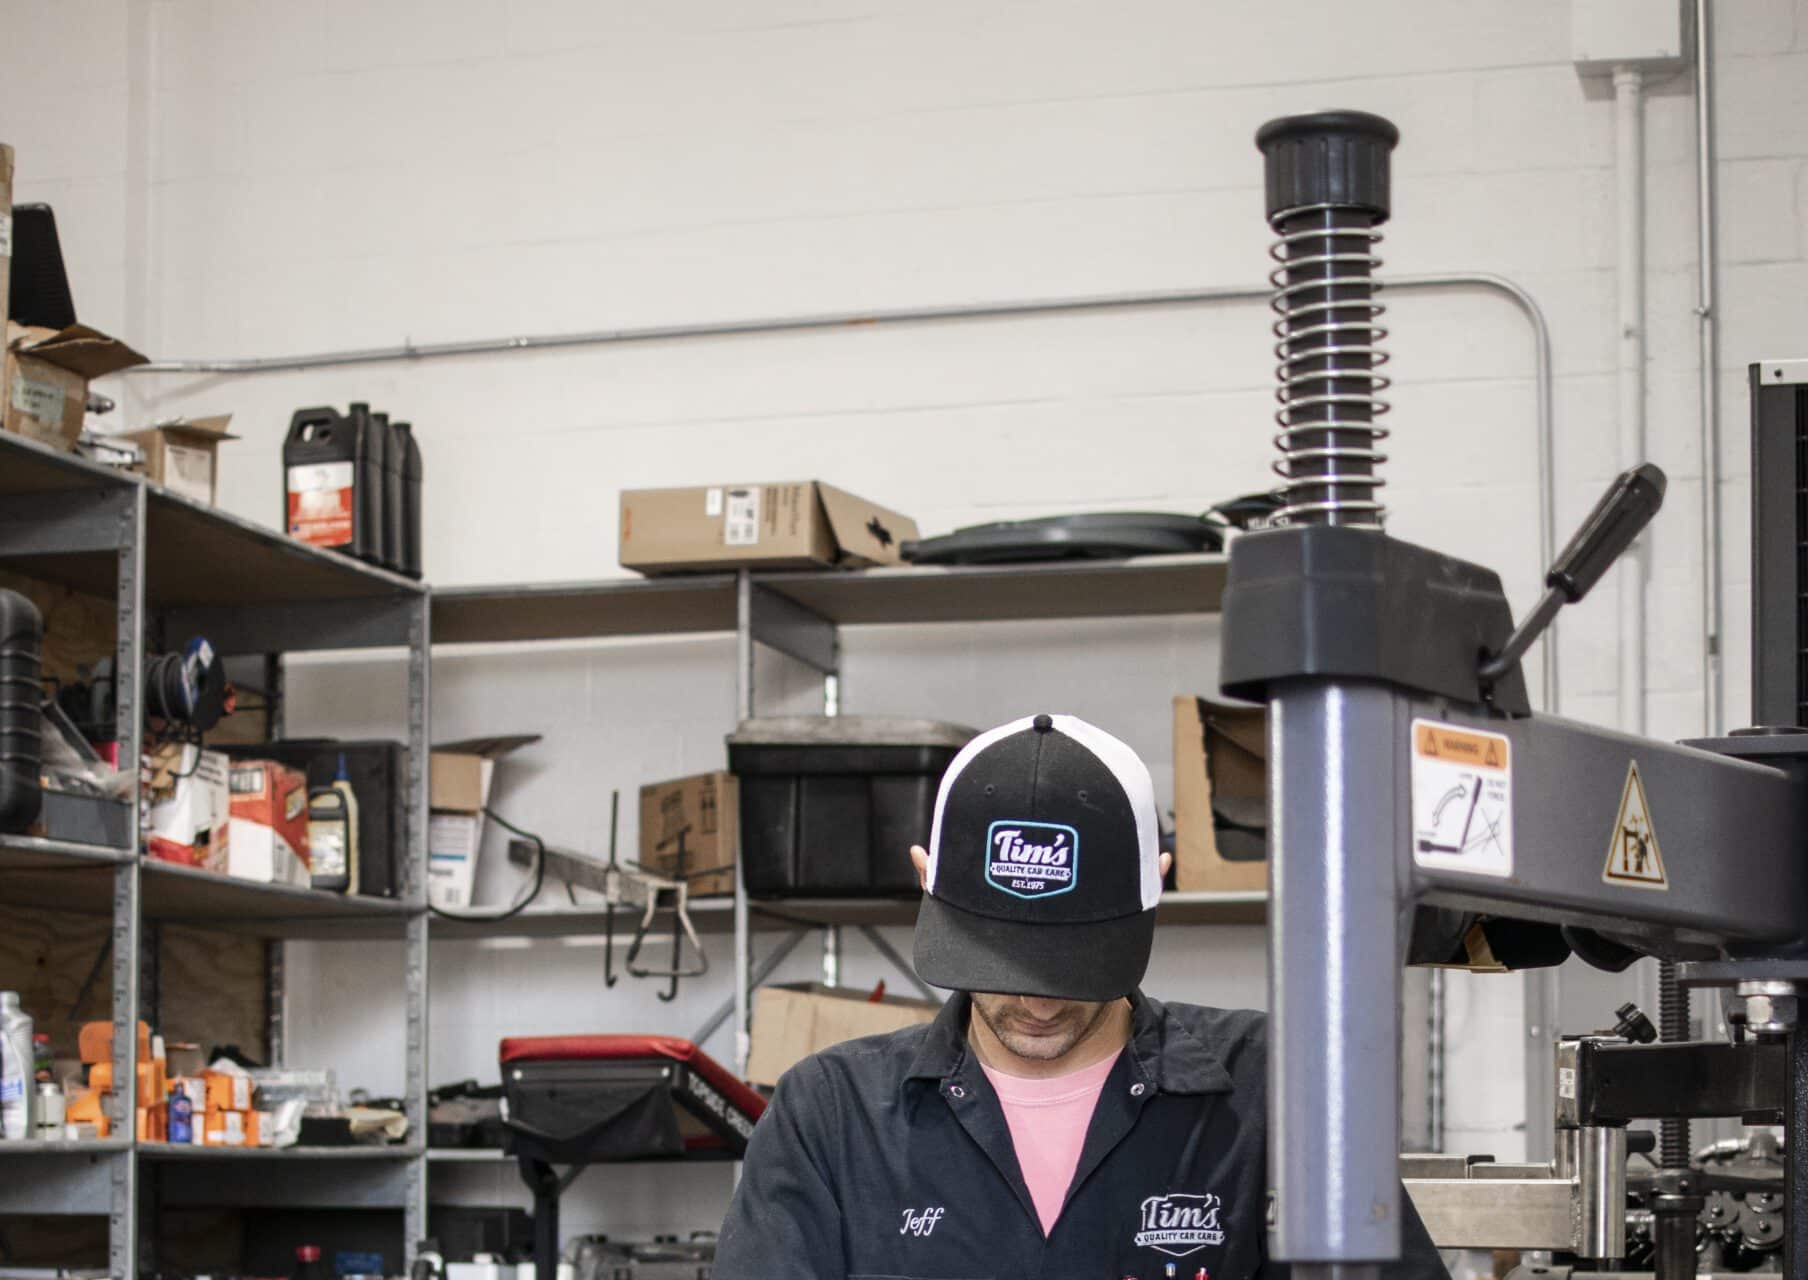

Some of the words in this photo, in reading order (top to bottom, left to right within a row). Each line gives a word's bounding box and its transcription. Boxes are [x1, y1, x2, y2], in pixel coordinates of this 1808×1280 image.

[994, 830, 1069, 865] Tim's
[996, 864, 1024, 874] QUALITY
[1027, 866, 1043, 875] CAR
[1045, 867, 1065, 877] CARE
[900, 1207, 945, 1237] Jeff
[1141, 1193, 1220, 1229] Tim's
[1144, 1232, 1178, 1241] QUALITY
[1180, 1232, 1195, 1240] CAR
[1198, 1232, 1217, 1241] CARE
